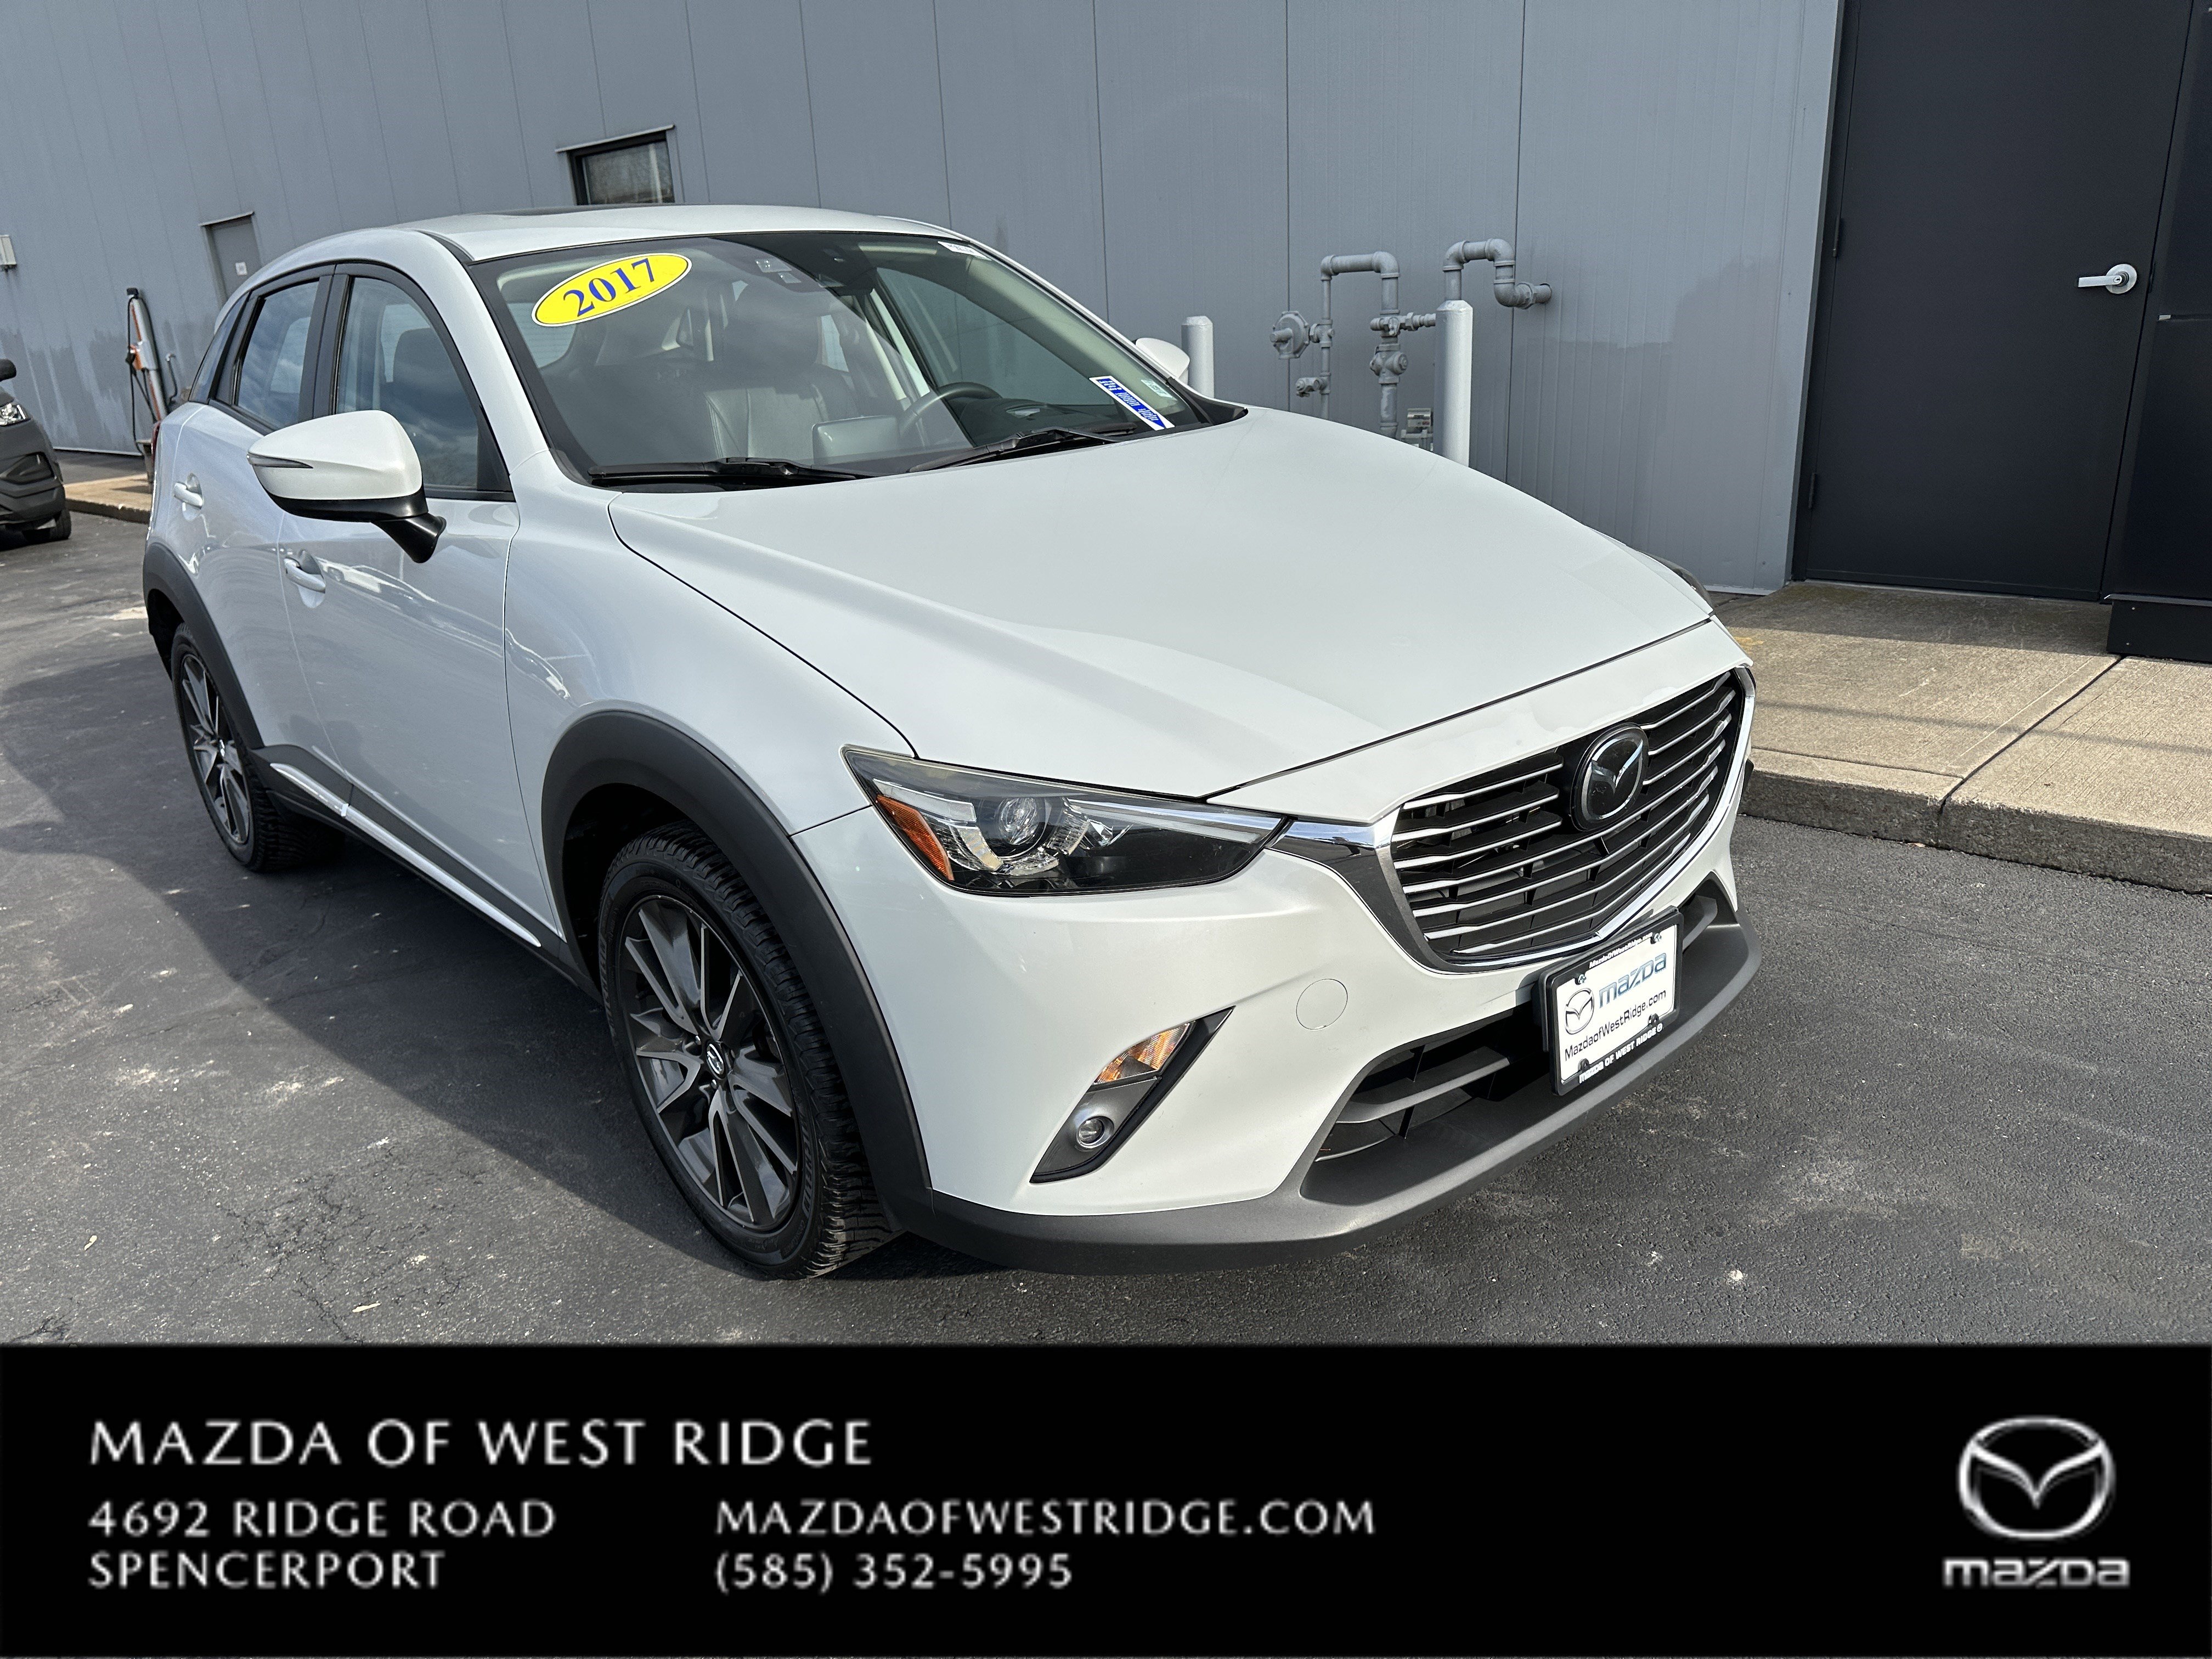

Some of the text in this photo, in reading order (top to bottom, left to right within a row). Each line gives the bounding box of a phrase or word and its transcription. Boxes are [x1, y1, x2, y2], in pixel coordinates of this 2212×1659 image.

[563, 257, 656, 318] 2017
[1565, 990, 1666, 1061] MazdaofWestRidge.com
[1605, 1053, 1615, 1067] OF
[1615, 1040, 1635, 1060] WEST
[1635, 1026, 1657, 1047] RIDGE
